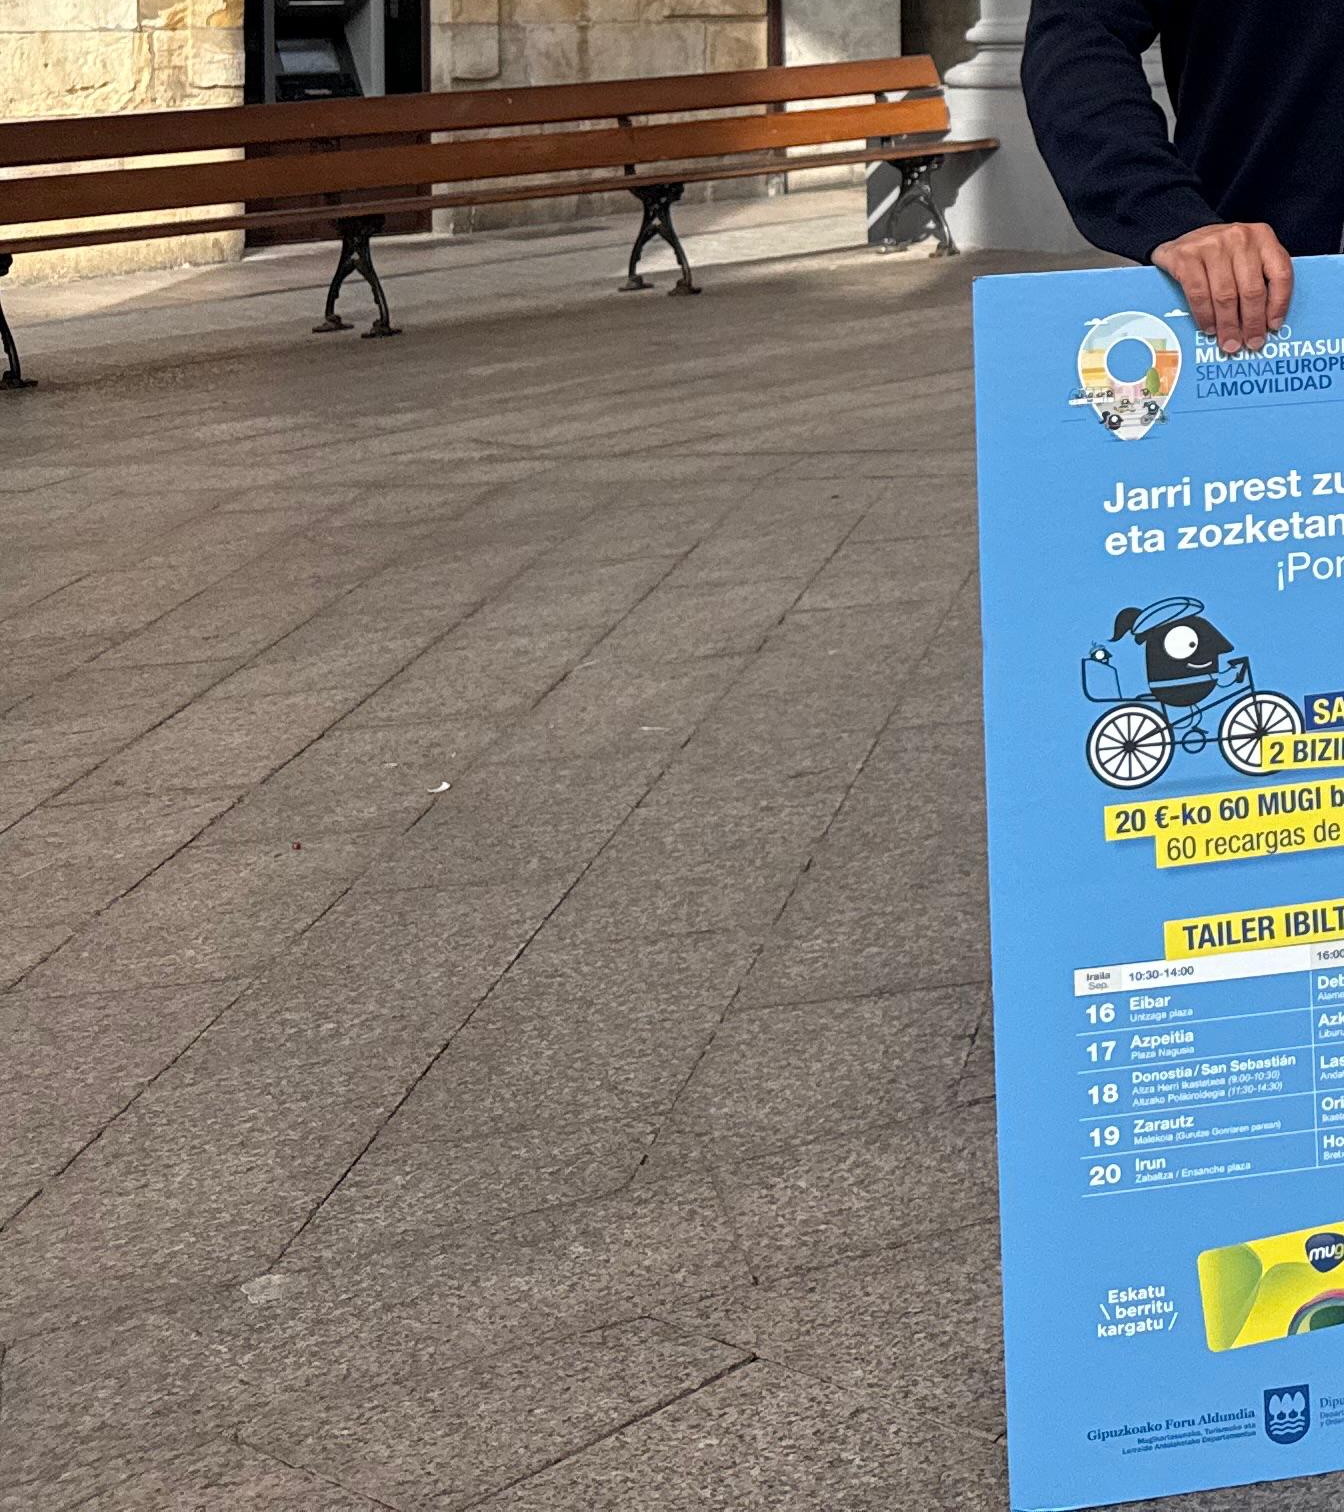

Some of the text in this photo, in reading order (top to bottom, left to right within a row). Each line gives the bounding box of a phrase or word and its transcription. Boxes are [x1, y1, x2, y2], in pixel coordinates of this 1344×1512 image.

[1103, 475, 1191, 514] Jarri
[1204, 469, 1302, 512] prest
[1105, 525, 1166, 556] eta
[1269, 741, 1285, 765] 2
[1115, 808, 1146, 834] 20
[1154, 803, 1212, 829] €-ko
[1218, 796, 1250, 822] 60
[1257, 786, 1322, 817] MUGI
[1166, 835, 1197, 866] 60
[1205, 826, 1306, 857] recargas
[1313, 818, 1341, 843] de
[1182, 915, 1276, 951] TAILER
[1128, 965, 1195, 982] 10:30-14:00
[1085, 1002, 1116, 1025] 16
[1129, 995, 1172, 1011] Eibar
[1130, 1029, 1195, 1049] Azpeitia
[1086, 1040, 1117, 1063] 17
[1229, 1054, 1296, 1072] Sebastián
[1088, 1083, 1119, 1105] 18
[1133, 1115, 1195, 1134] Zarautz
[1089, 1125, 1120, 1147] 19
[1089, 1163, 1122, 1186] 20
[1135, 1157, 1167, 1172] Irun
[1107, 1285, 1166, 1304] Eskatu
[1115, 1300, 1174, 1320] berritu
[1097, 1316, 1164, 1338] kargatu
[1086, 1421, 1163, 1442] Gipuzkoako
[1165, 1418, 1196, 1430] Foru
[1197, 1408, 1256, 1426] Aldundia
